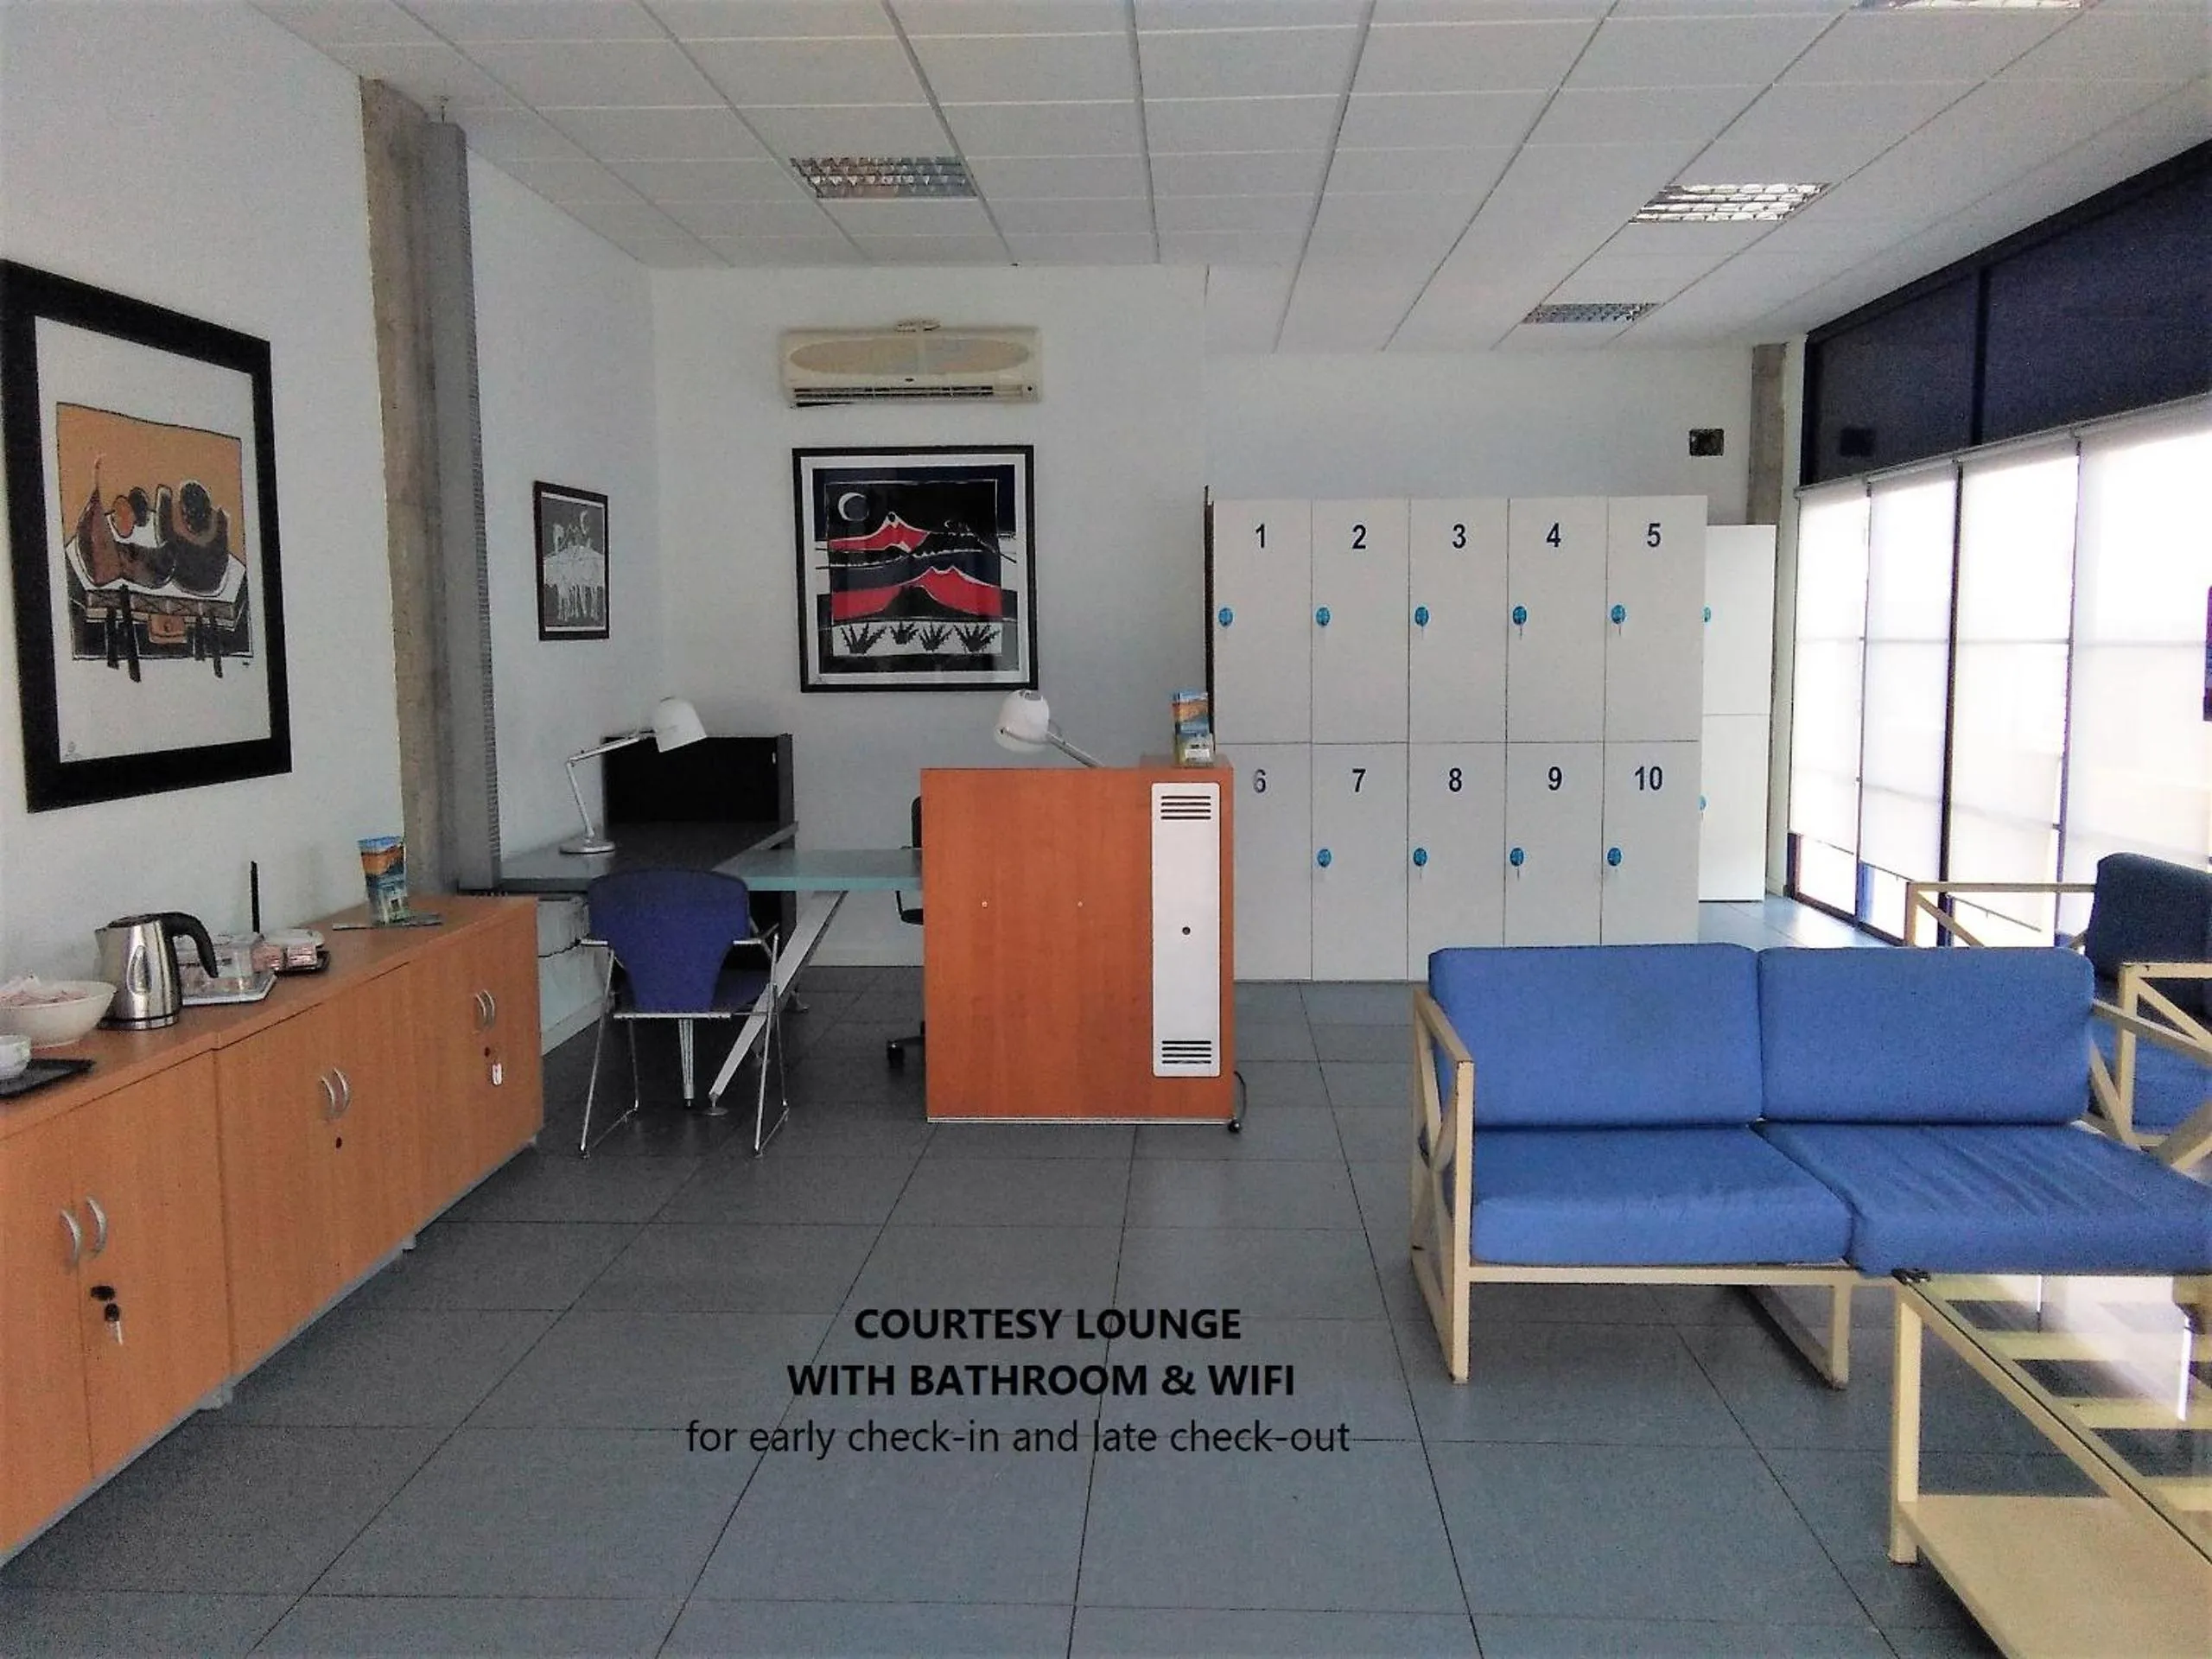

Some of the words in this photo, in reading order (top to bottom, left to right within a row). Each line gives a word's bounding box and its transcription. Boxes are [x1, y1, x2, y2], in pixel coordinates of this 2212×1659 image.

[1255, 524, 1265, 549] 1
[1351, 524, 1367, 550] 2
[1452, 523, 1467, 550] 3
[1546, 522, 1562, 548] 4
[1646, 522, 1662, 548] 5
[1253, 768, 1267, 794] 6
[1351, 767, 1367, 793] 7
[1448, 767, 1463, 793] 8
[1548, 766, 1563, 791] 9
[1634, 766, 1663, 791] 10
